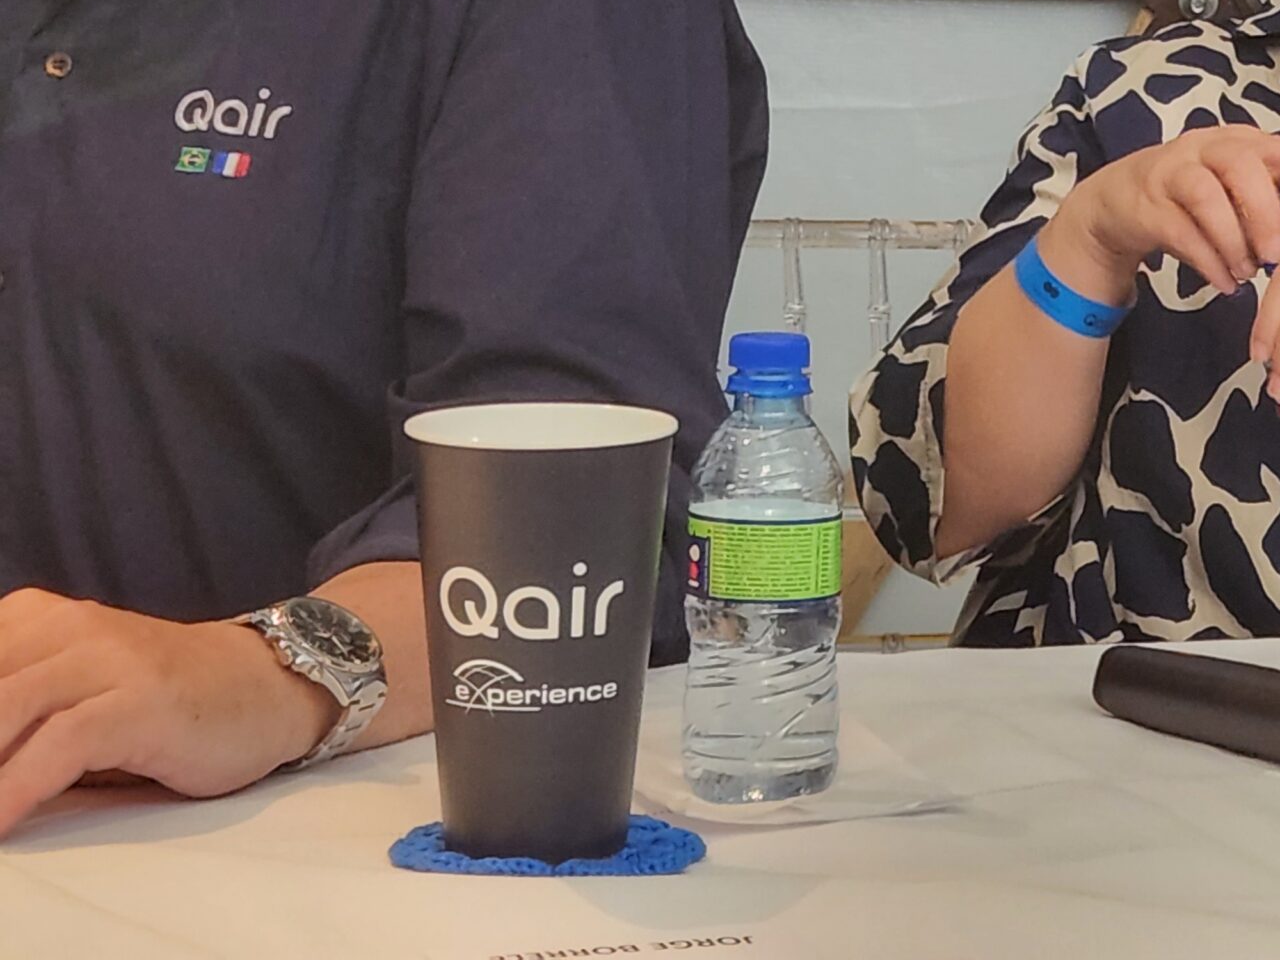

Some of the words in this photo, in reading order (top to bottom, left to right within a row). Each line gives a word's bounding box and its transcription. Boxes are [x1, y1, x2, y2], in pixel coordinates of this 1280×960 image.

[175, 87, 292, 139] Qair
[440, 562, 624, 640] Qair
[650, 936, 753, 951] JORGE
